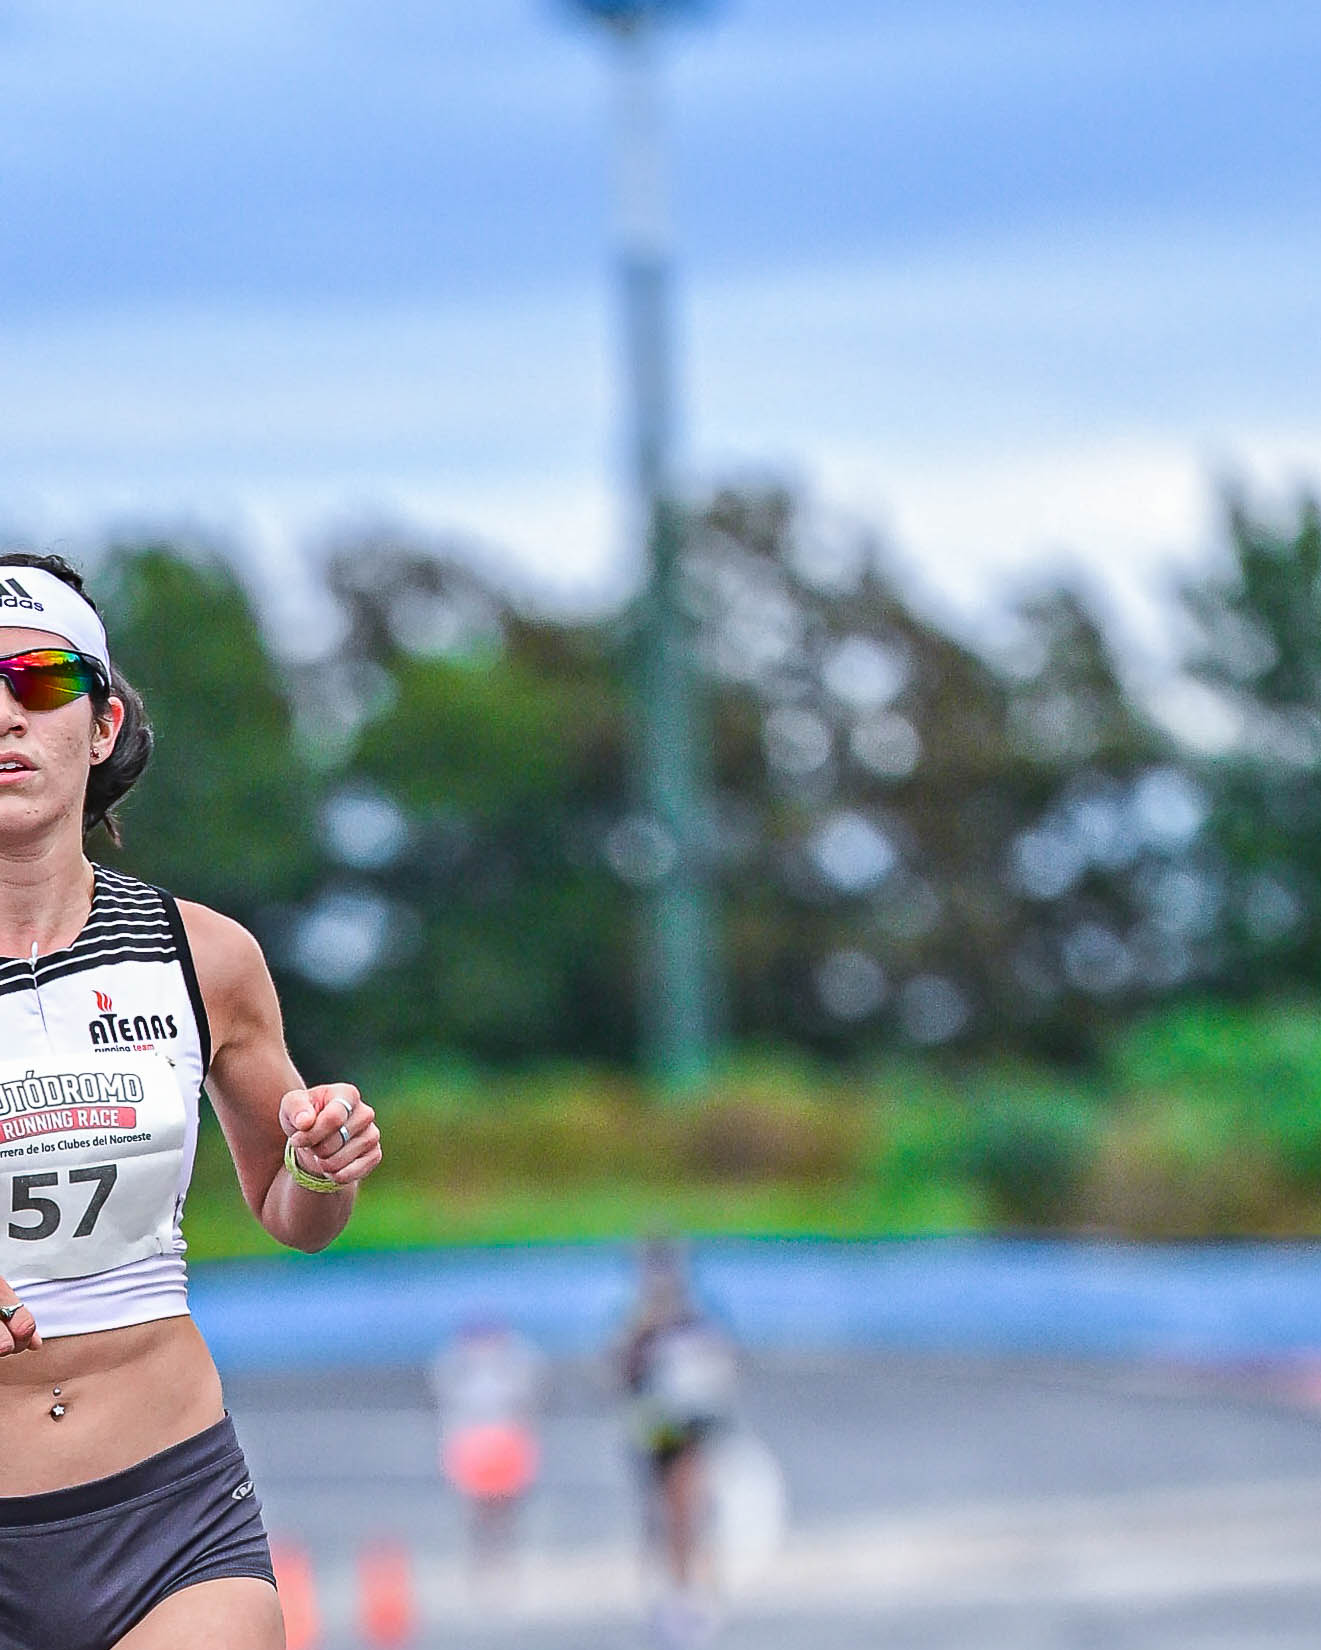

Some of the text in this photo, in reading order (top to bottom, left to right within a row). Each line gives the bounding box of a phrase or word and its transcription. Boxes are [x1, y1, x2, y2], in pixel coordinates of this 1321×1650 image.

[88, 1013, 178, 1045] ATENAS
[133, 1044, 155, 1052] team
[2, 1109, 120, 1140] RUNNING RACE
[26, 1144, 39, 1155] de
[41, 1142, 55, 1153] los
[58, 1138, 91, 1151] Clubes
[93, 1135, 108, 1147] del
[110, 1132, 152, 1146] Noroeste
[8, 1164, 118, 1241] 57
